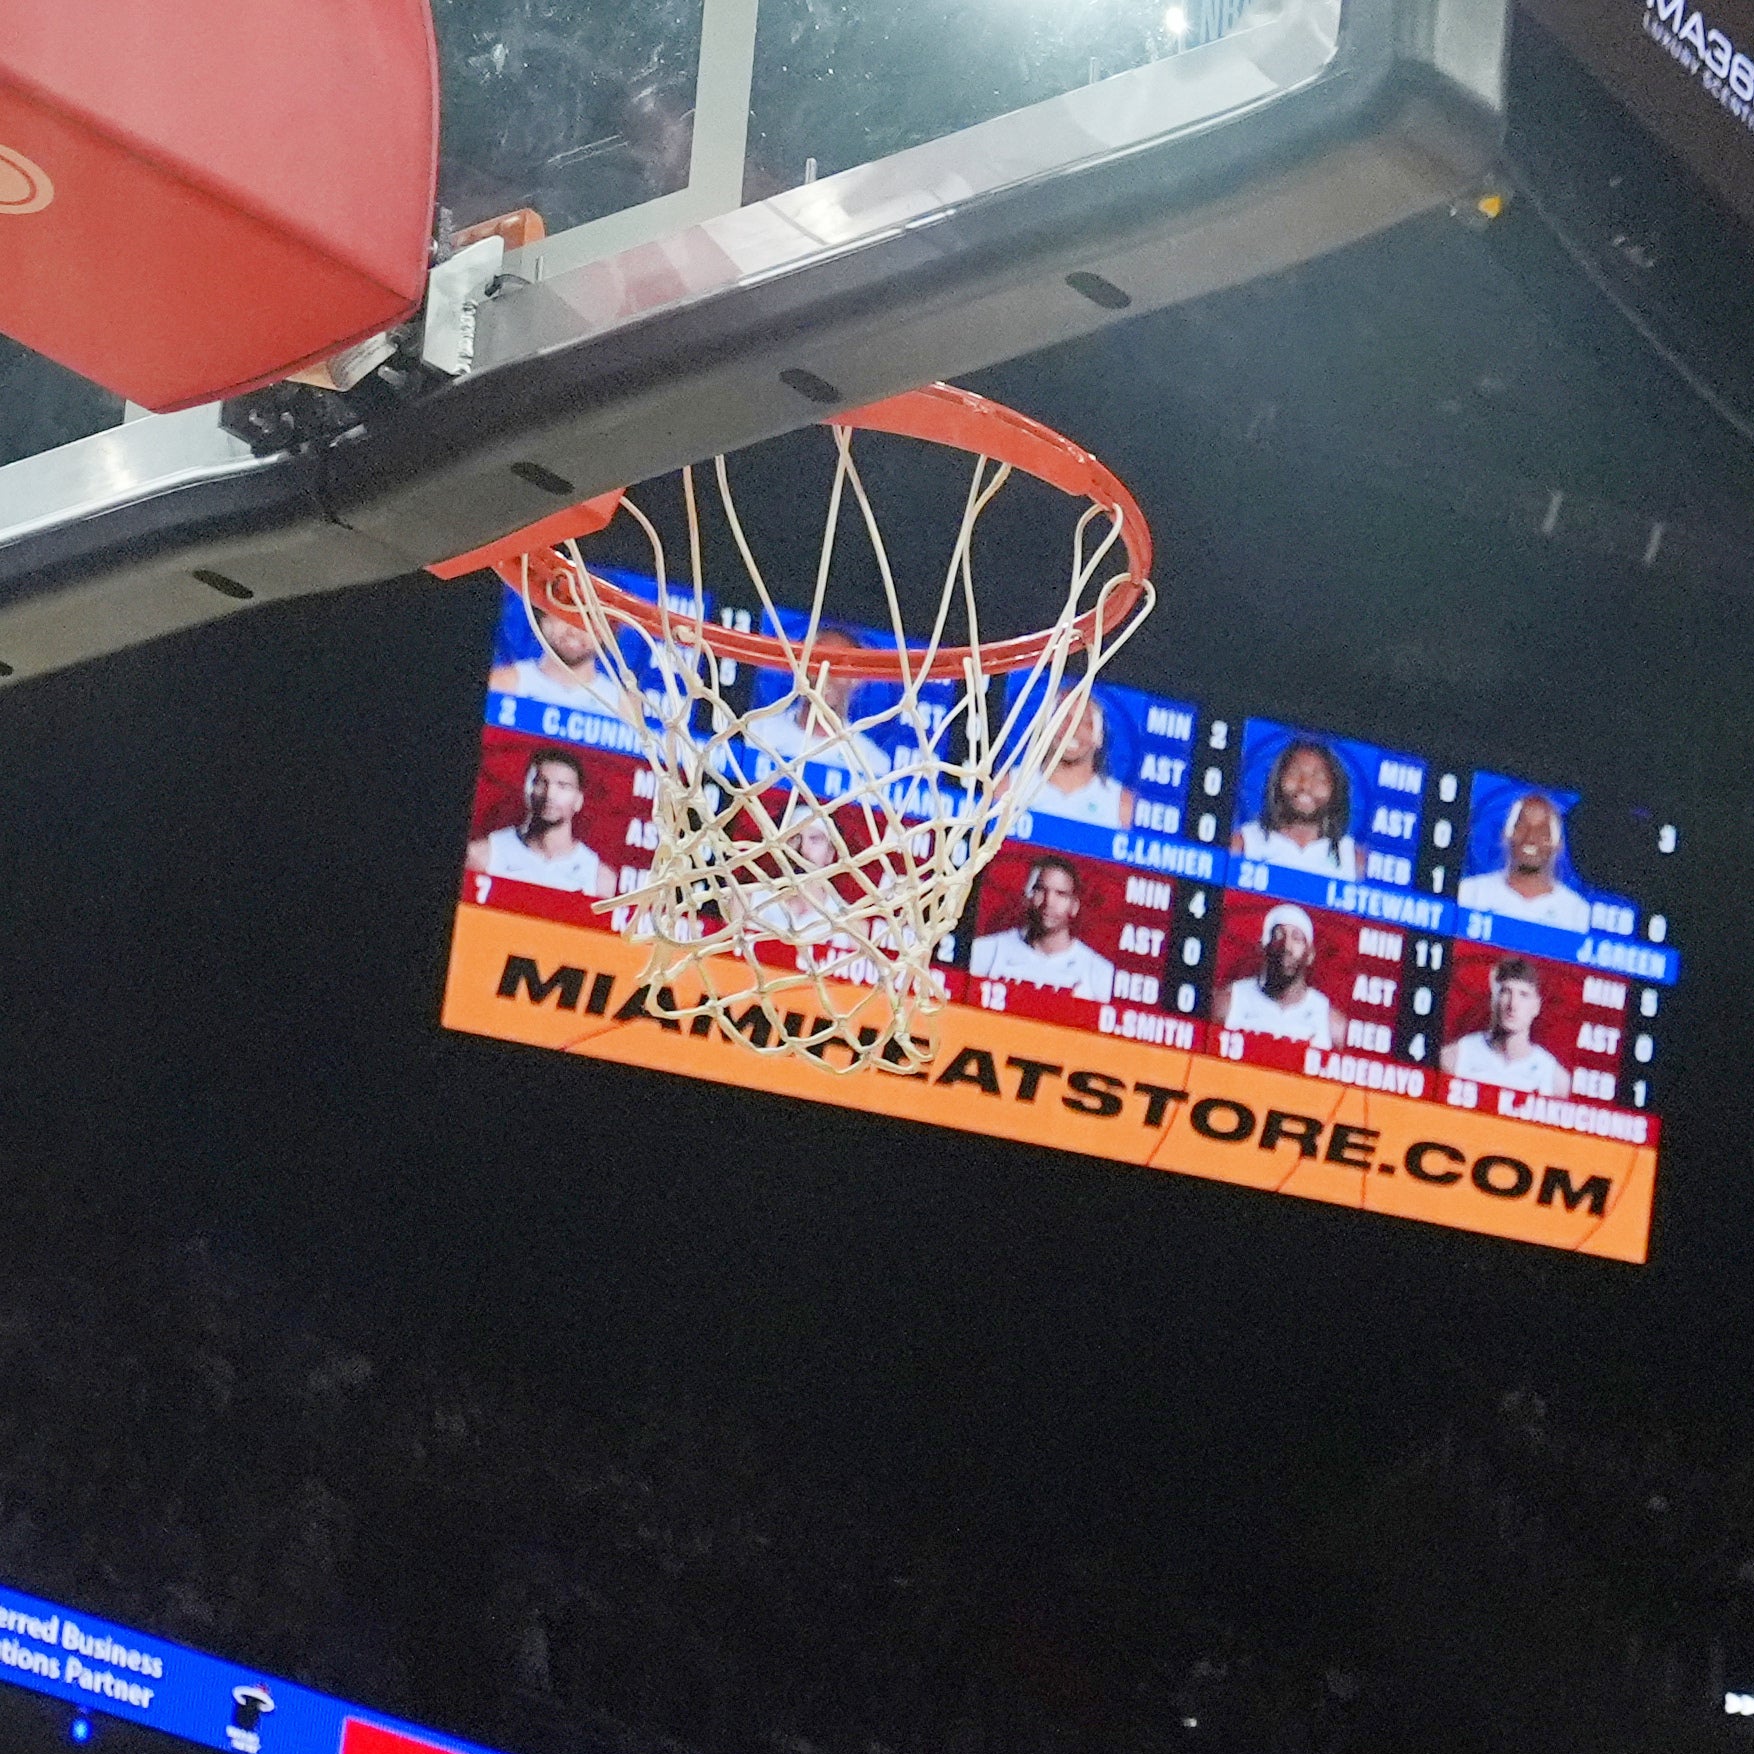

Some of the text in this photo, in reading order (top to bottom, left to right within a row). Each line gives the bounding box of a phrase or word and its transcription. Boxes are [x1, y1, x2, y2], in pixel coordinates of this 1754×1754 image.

[500, 700, 515, 725] 2
[1146, 706, 1229, 750] MIN 2
[1140, 754, 1187, 788] AST
[1372, 806, 1417, 840] AST
[476, 876, 491, 904] 7
[1432, 866, 1445, 893] 1
[1125, 876, 1206, 919] MIN 4
[1119, 923, 1166, 957] AST
[1415, 940, 1443, 971] 11
[1352, 974, 1398, 1007] AST
[1099, 1005, 1195, 1050] D.SMITH
[1408, 1033, 1426, 1061] 4
[496, 953, 1614, 1220] MIAMIHEATSTORE.COM
[1633, 1080, 1647, 1108] 1
[61, 1617, 164, 1681] Business
[64, 1661, 155, 1711] Partner
